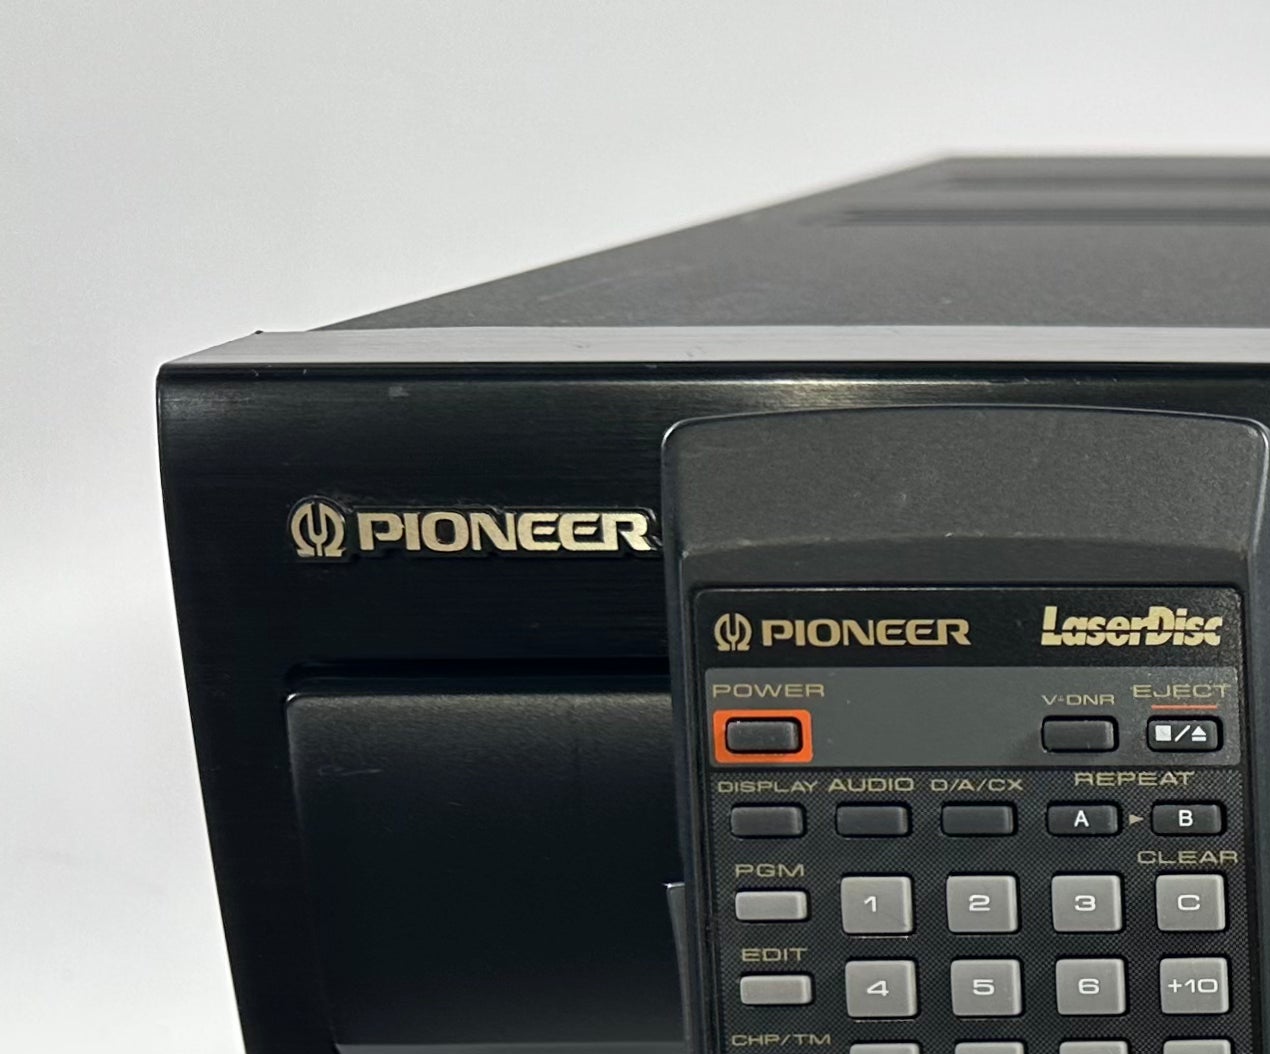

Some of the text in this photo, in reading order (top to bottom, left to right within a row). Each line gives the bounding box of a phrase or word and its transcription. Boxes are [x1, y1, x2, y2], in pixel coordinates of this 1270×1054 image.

[356, 511, 651, 553] PIONEER
[761, 617, 972, 647] PIONEER
[1040, 606, 1224, 647] LaserDisc
[712, 683, 826, 698] POWER
[1131, 684, 1231, 699] EJECT
[828, 777, 914, 792] AUDIO
[930, 778, 1024, 792] D/A/CX
[1073, 771, 1195, 787] REPEAT
[717, 781, 818, 794] DISPLAY
[1073, 811, 1090, 828] A
[1179, 810, 1194, 827] B
[1137, 850, 1238, 865] CLEAR
[735, 864, 805, 878] PGM
[863, 896, 878, 913] 1
[968, 895, 991, 911] 2
[1074, 895, 1096, 911] 3
[1177, 894, 1201, 911] C
[742, 947, 807, 961] EDIT
[866, 980, 890, 997] 4
[972, 979, 995, 996] 5
[1078, 978, 1100, 994] 6
[1168, 978, 1218, 994] +10
[731, 1034, 831, 1046] CHP/TM
